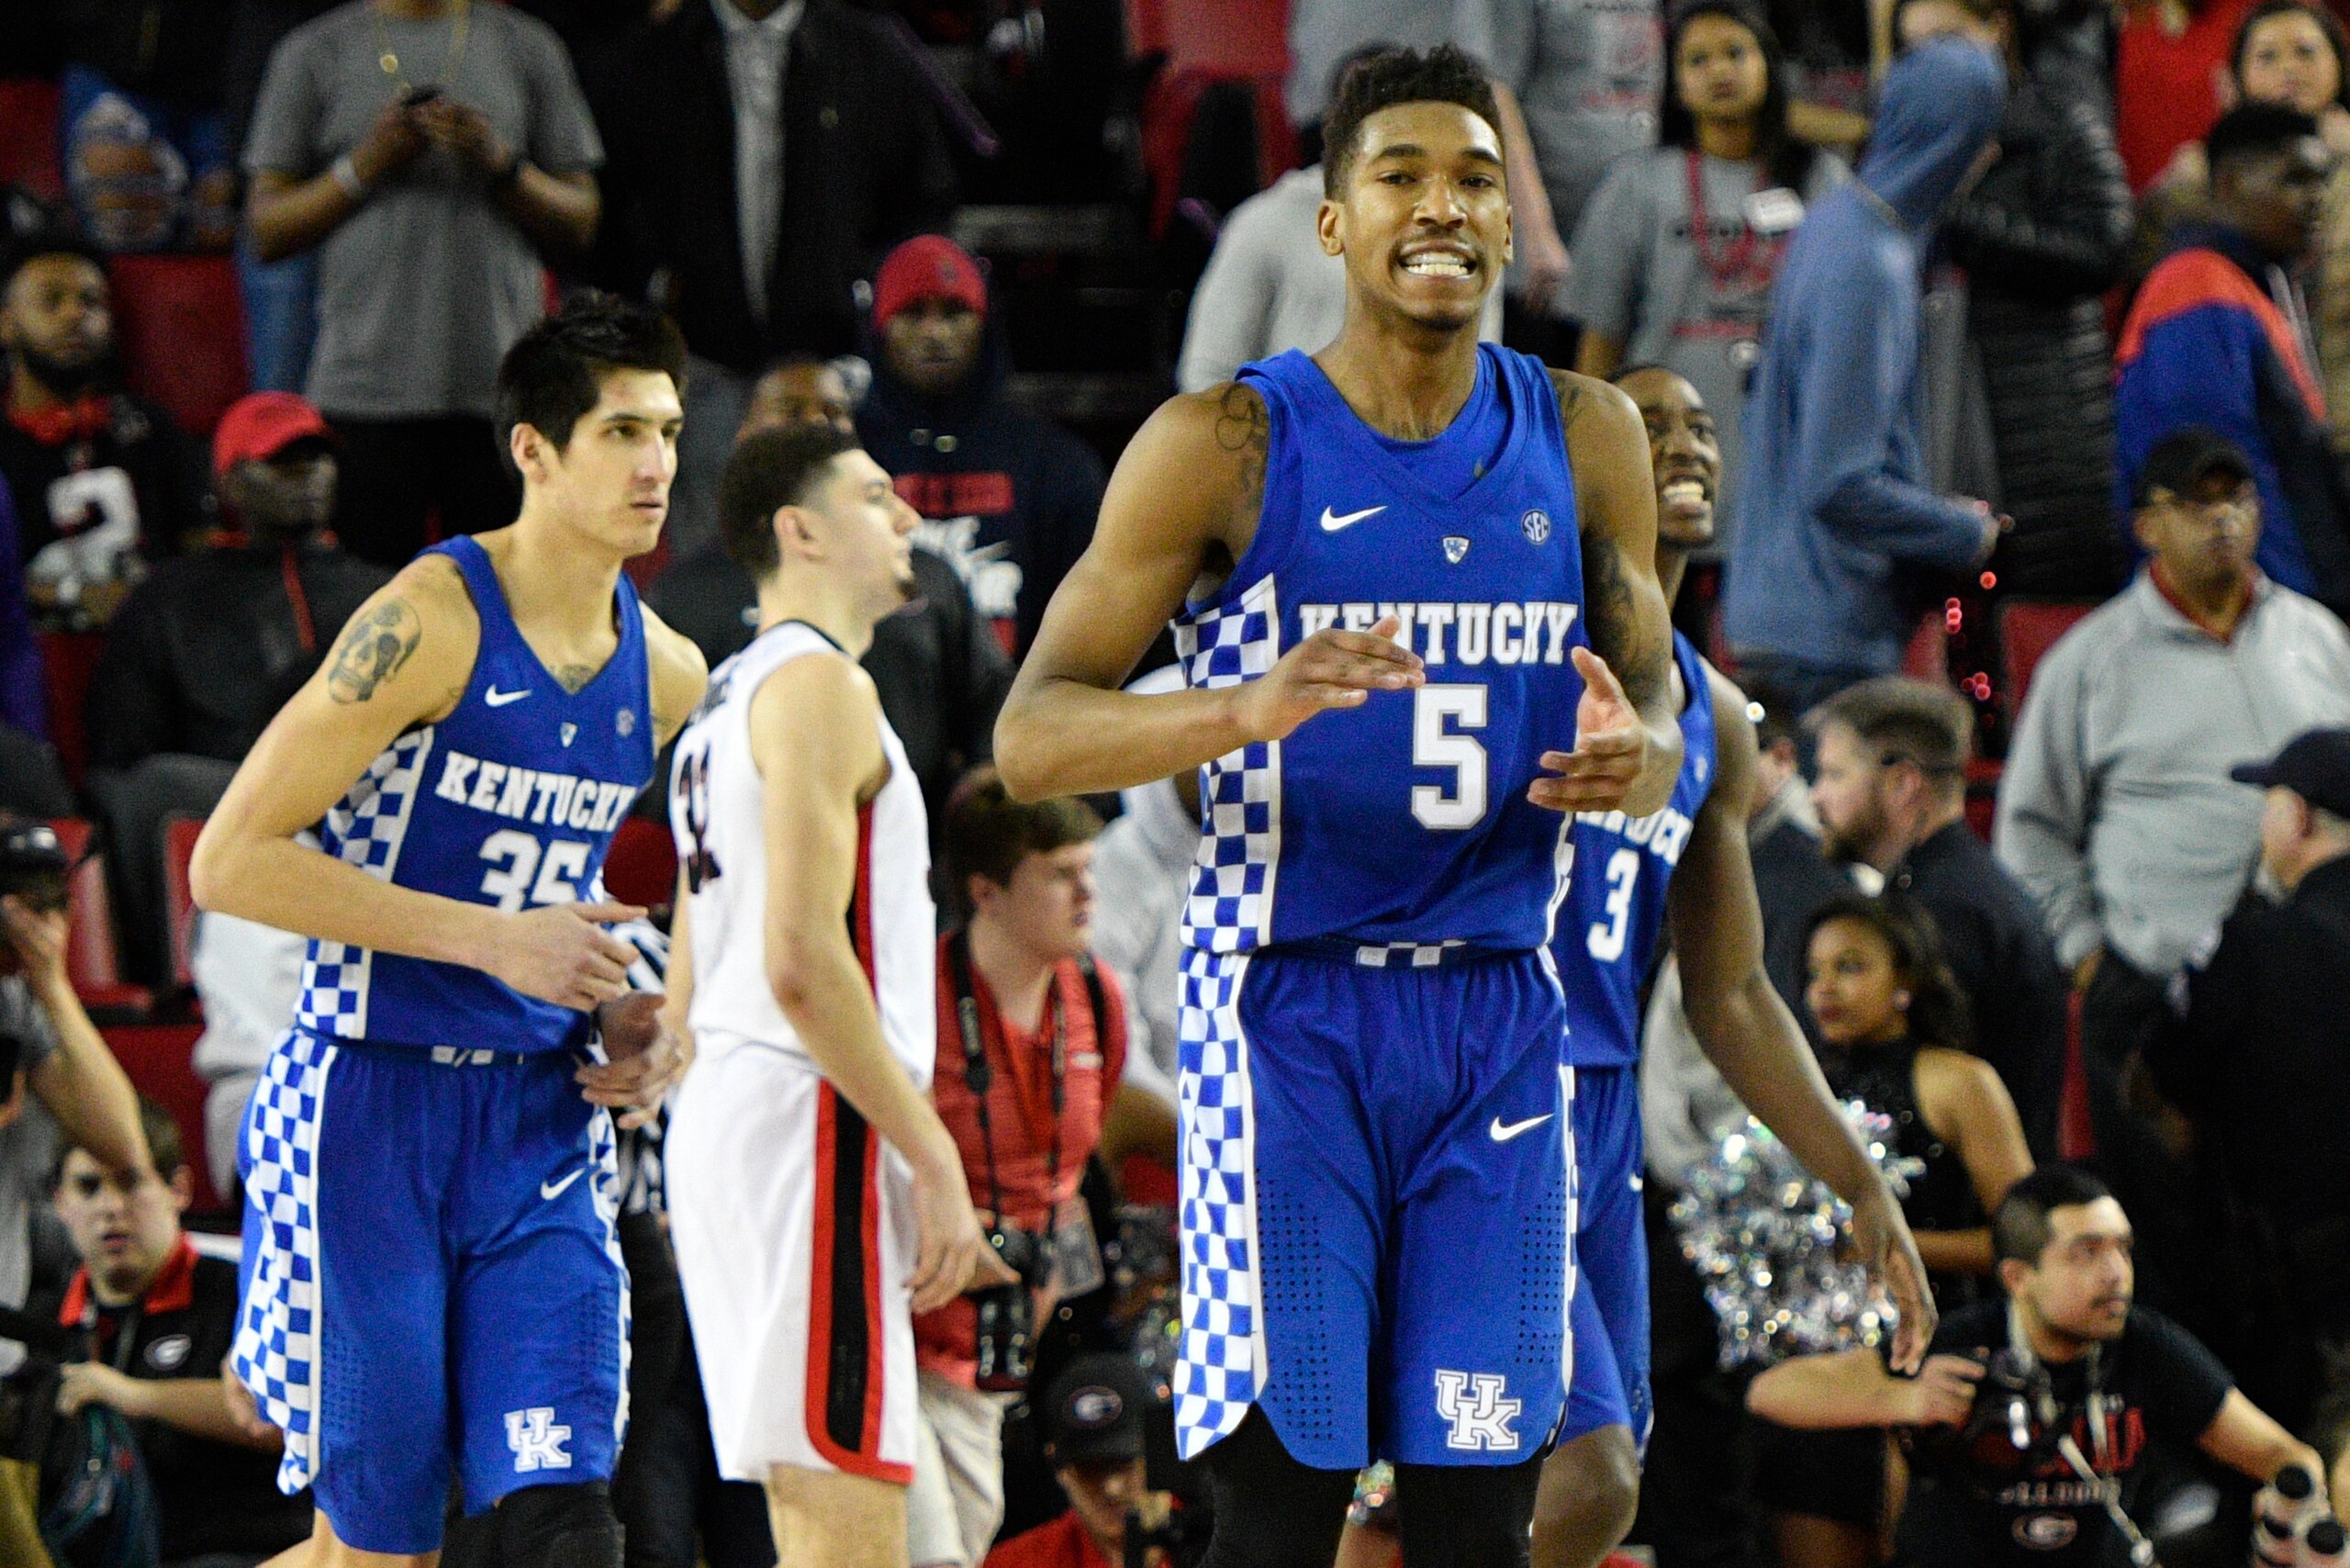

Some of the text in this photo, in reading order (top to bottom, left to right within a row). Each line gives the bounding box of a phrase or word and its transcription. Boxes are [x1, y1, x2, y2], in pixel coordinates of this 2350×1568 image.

[1524, 511, 1549, 542] SEC
[434, 750, 636, 832] KENTUCKY
[1411, 683, 1488, 830] 5
[478, 828, 592, 915] 35
[1586, 846, 1639, 962] 3
[503, 1406, 572, 1473] UK
[1435, 1369, 1521, 1450] UK
